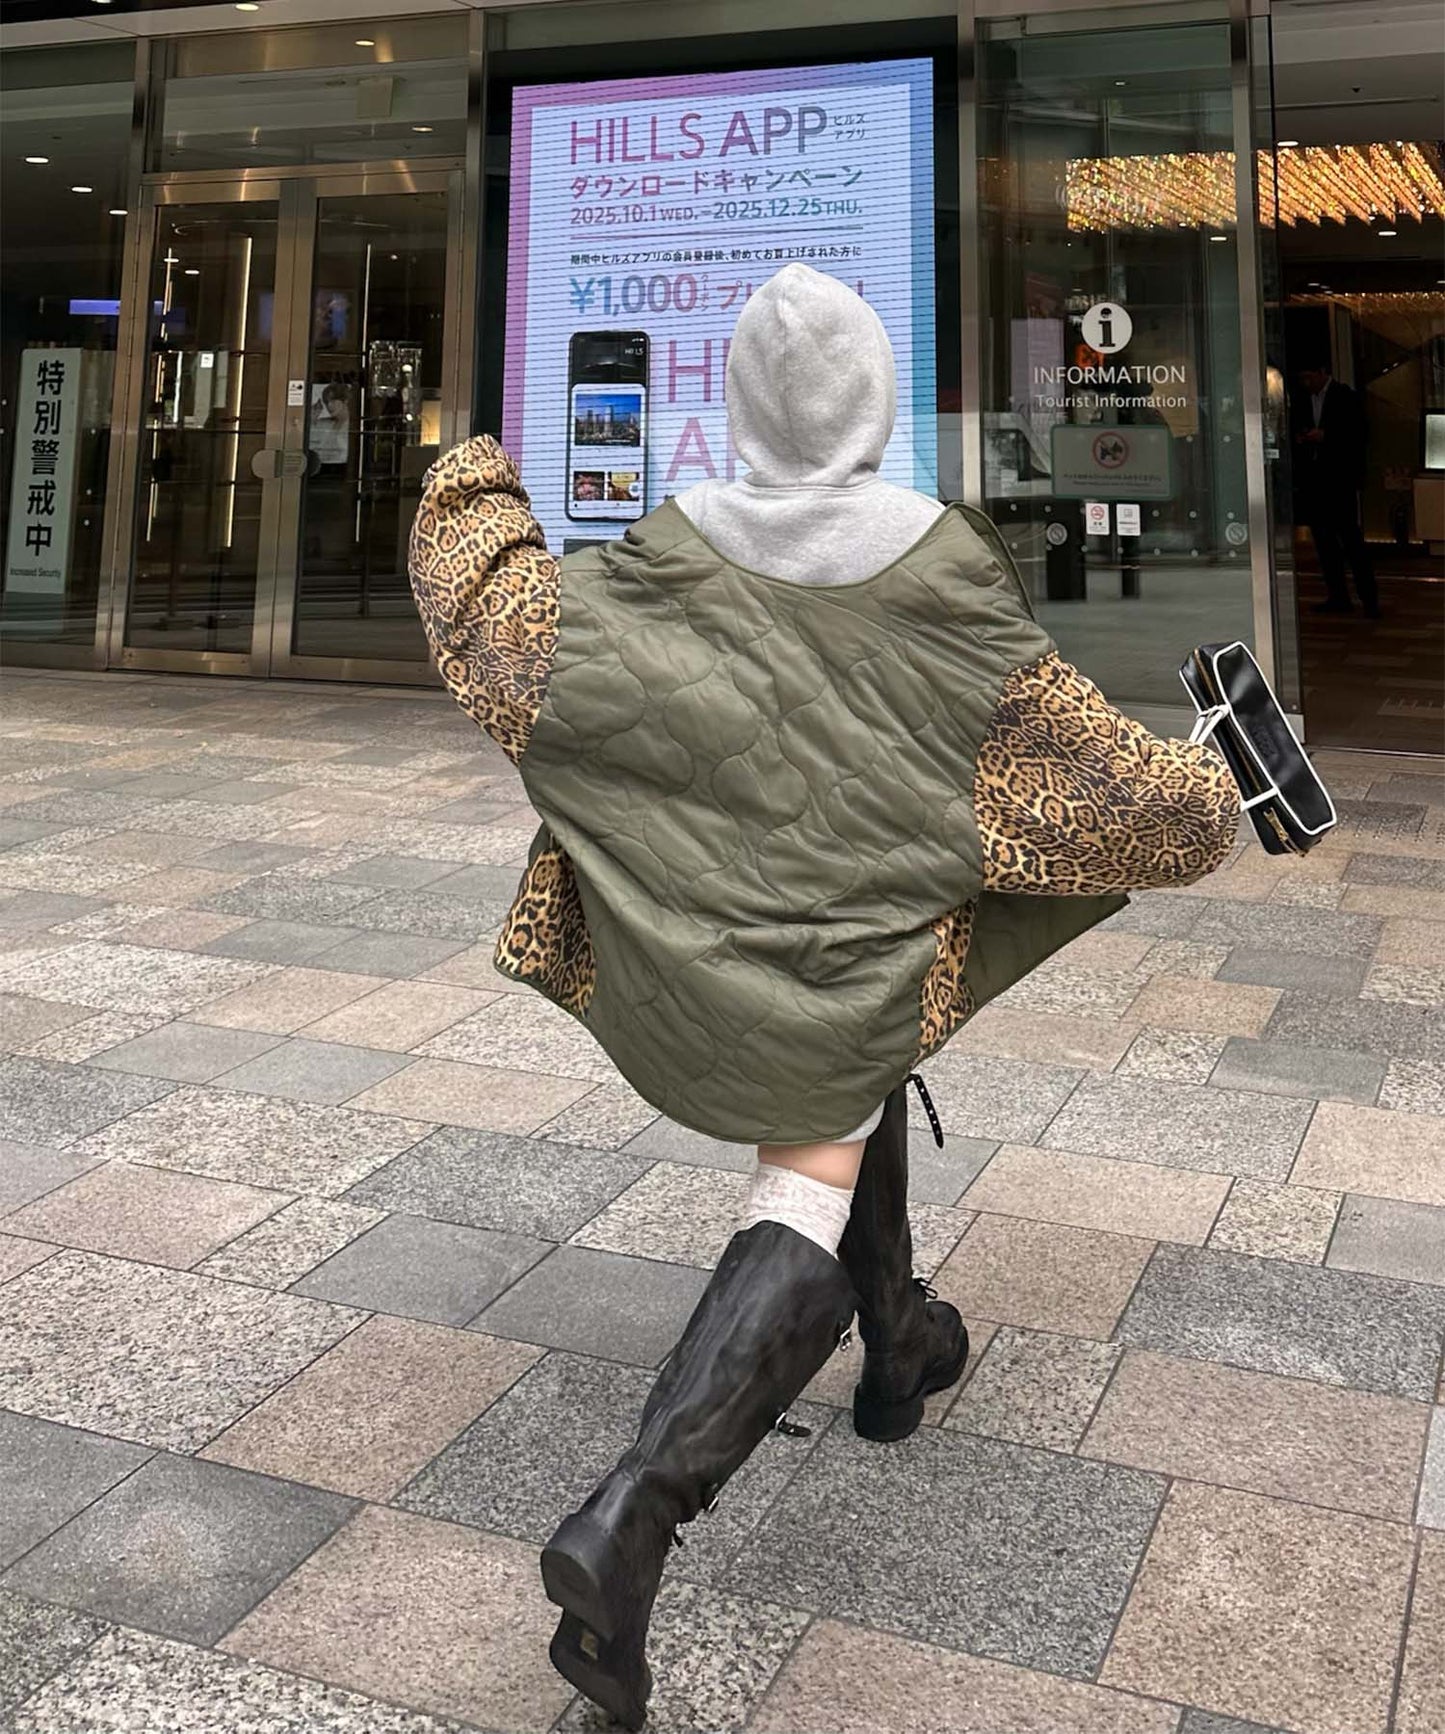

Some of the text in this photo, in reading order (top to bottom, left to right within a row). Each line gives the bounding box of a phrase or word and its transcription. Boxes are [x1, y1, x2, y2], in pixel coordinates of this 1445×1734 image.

[571, 106, 827, 164] HILLS APP
[834, 129, 865, 140] アプリ
[570, 166, 863, 199] ダウンロードキャンペーン
[569, 273, 698, 316] ¥1,000
[1034, 365, 1186, 385] INFORMATION
[1035, 393, 1186, 408] Tourist Information
[25, 360, 65, 556] 特別警戒中
